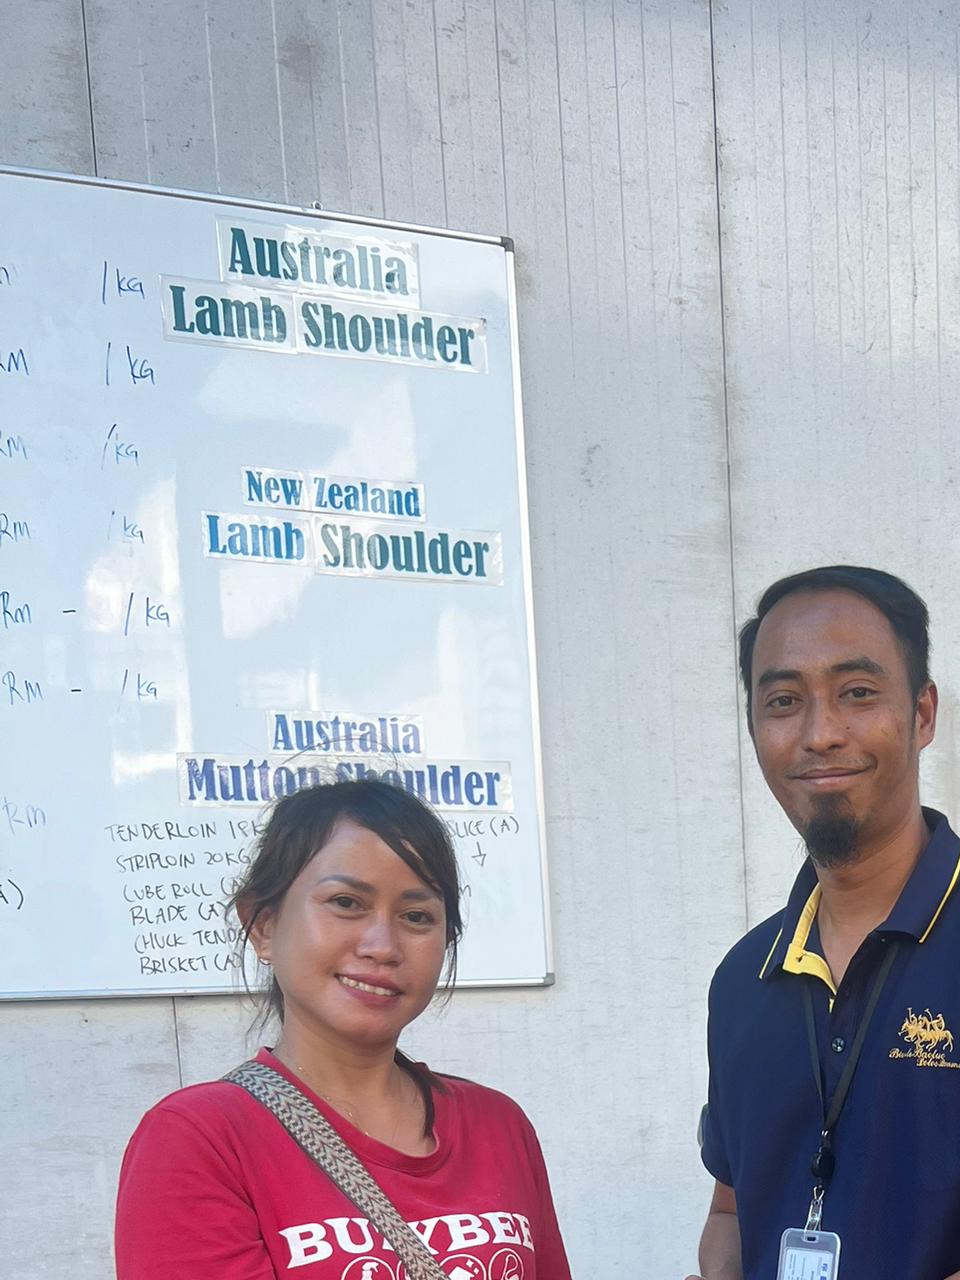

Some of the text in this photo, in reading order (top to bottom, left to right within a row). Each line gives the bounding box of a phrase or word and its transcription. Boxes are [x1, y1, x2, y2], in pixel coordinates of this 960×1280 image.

[228, 227, 409, 296] Australia
[169, 285, 475, 366] Lamb Shoulder
[245, 470, 421, 518] New Zealand
[206, 514, 489, 577] Lamb Shoulder
[273, 713, 422, 754] Australia
[185, 757, 321, 802] Mutton
[104, 821, 217, 842] TENDERLOIN
[490, 816, 519, 837] (A)
[116, 852, 195, 873] STRIPLOIN
[129, 904, 188, 926] BLADE
[134, 932, 186, 954] CHUCK
[139, 955, 207, 976] BRISKET
[278, 1211, 536, 1269] BUYBEE
